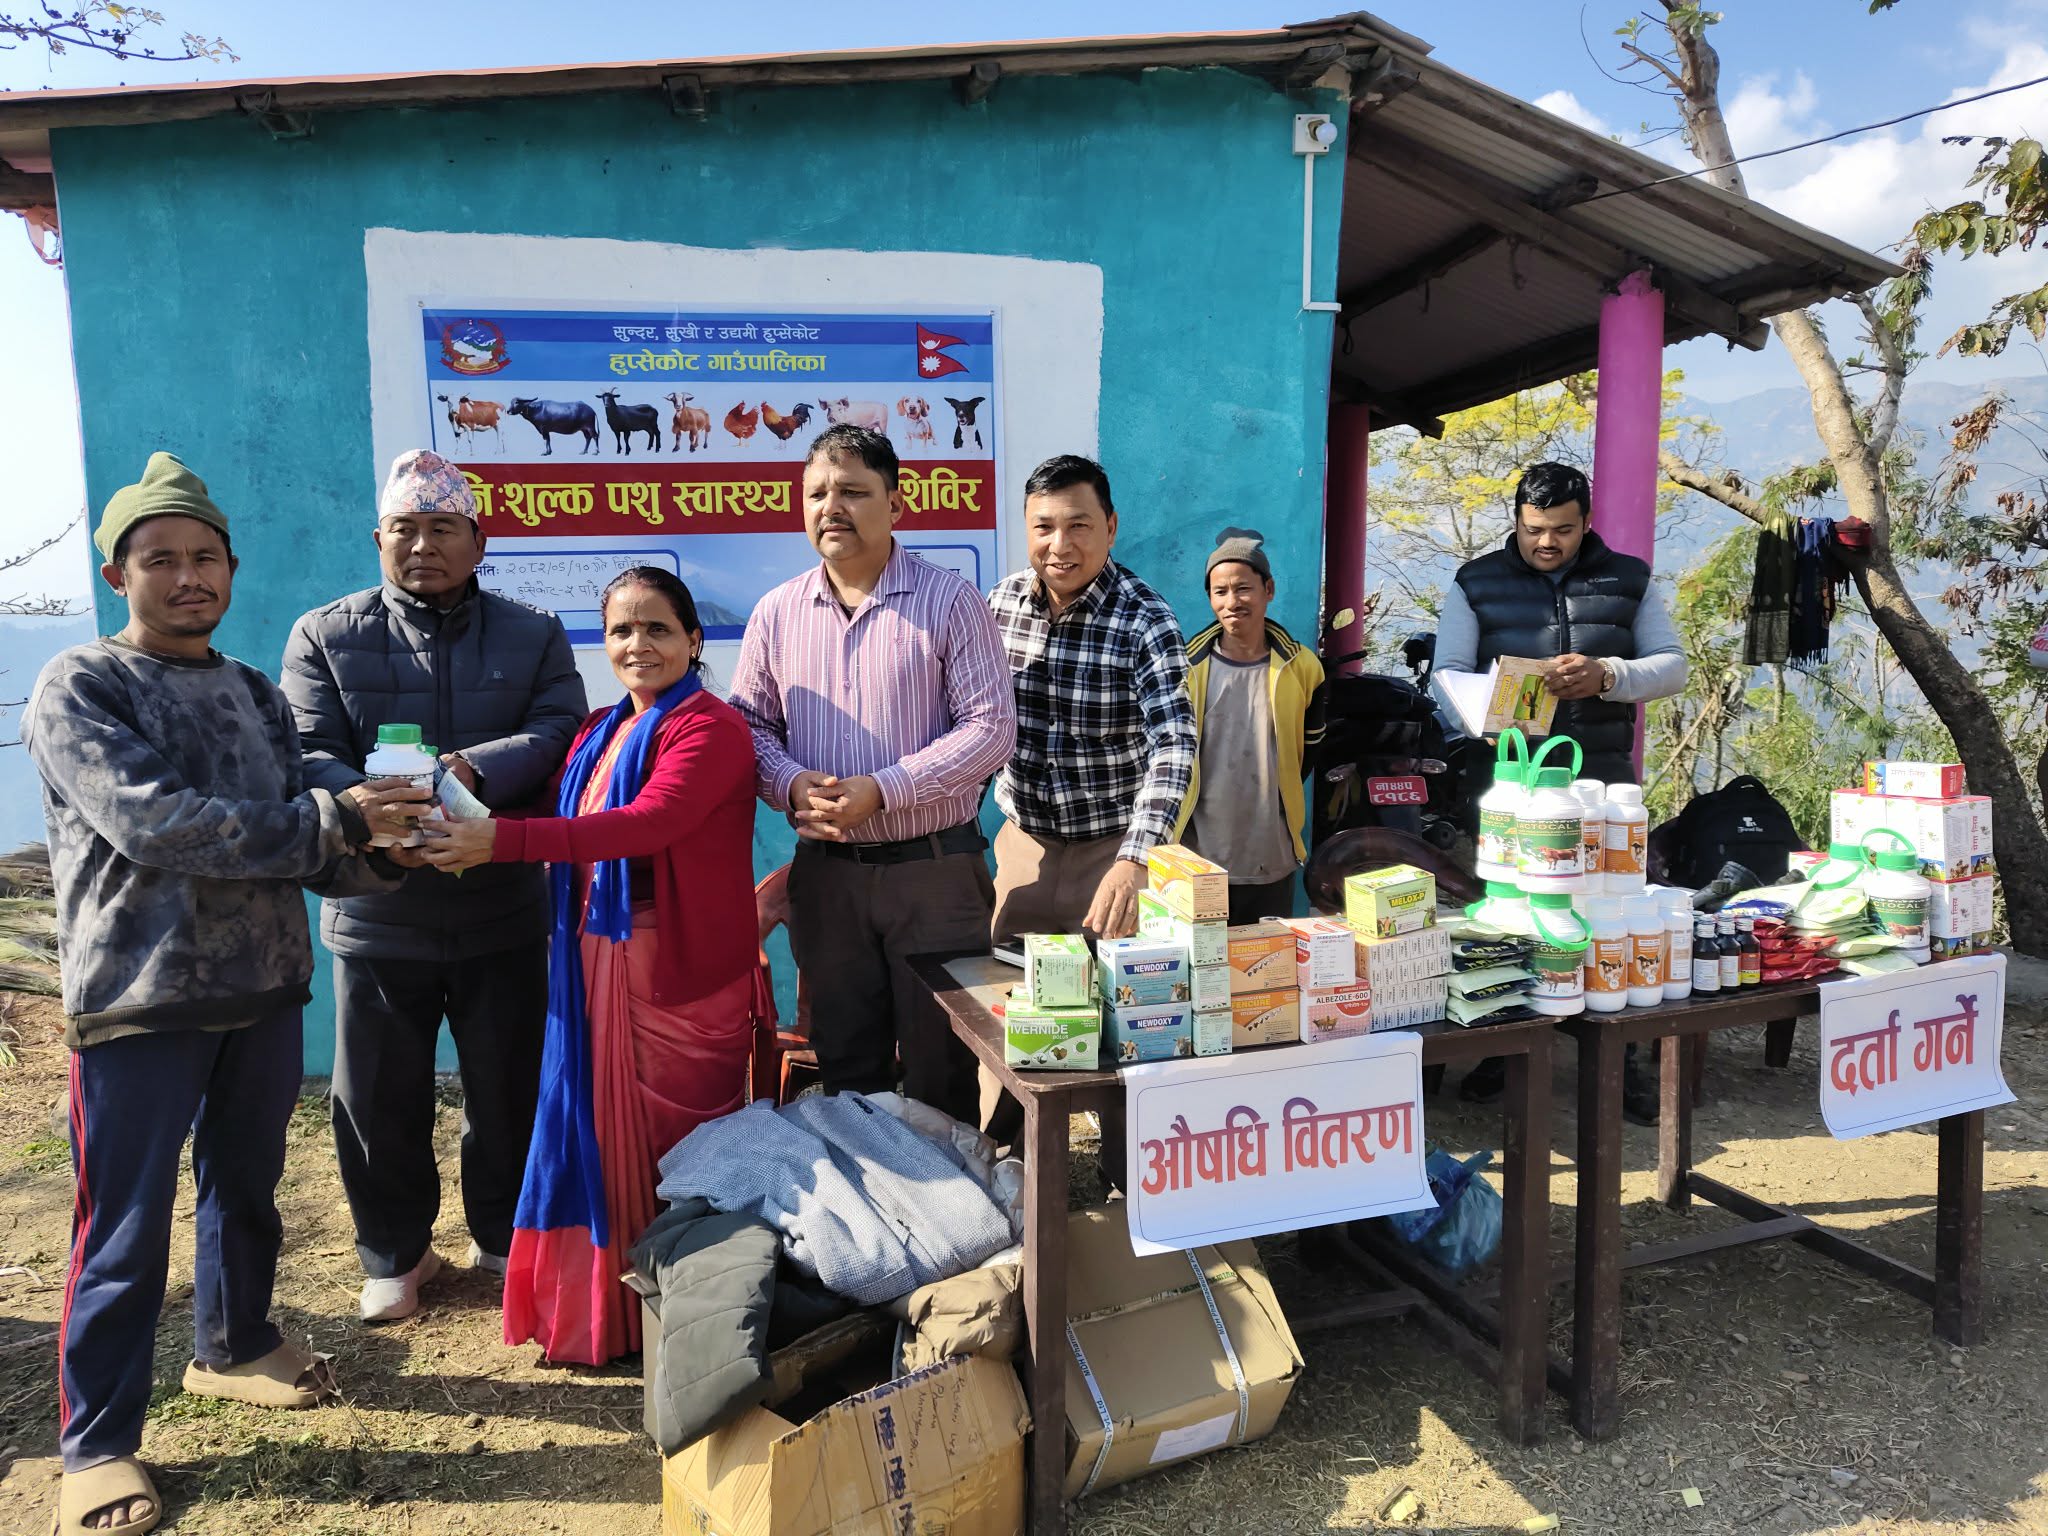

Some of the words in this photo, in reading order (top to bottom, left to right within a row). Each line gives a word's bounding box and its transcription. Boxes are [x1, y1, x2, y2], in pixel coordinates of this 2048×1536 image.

[613, 325, 659, 342] सुन्दर,
[665, 322, 700, 342] सुखी
[704, 327, 715, 339] र
[718, 322, 758, 339] उद्यमी
[762, 322, 820, 343] हुप्सेकोट
[609, 348, 700, 375] हुप्सेकोट
[707, 348, 827, 372] गाउँपालिका
[604, 481, 665, 525] पशु
[671, 480, 793, 517] स्वास्थ्य
[1134, 962, 1170, 973] NEWDOXY
[1316, 992, 1368, 1004] ALBEZOLE-600
[1010, 1024, 1068, 1034] IVERNIDE
[1138, 1017, 1172, 1028] NEWDOXY
[1830, 1009, 1902, 1097] दर्ता
[1913, 994, 1979, 1072] गर्ने
[1140, 1105, 1270, 1196] औषधि
[1282, 1096, 1416, 1172] वितरण
[1216, 1318, 1225, 1336] MDH
[1078, 1358, 1091, 1376] MDH
